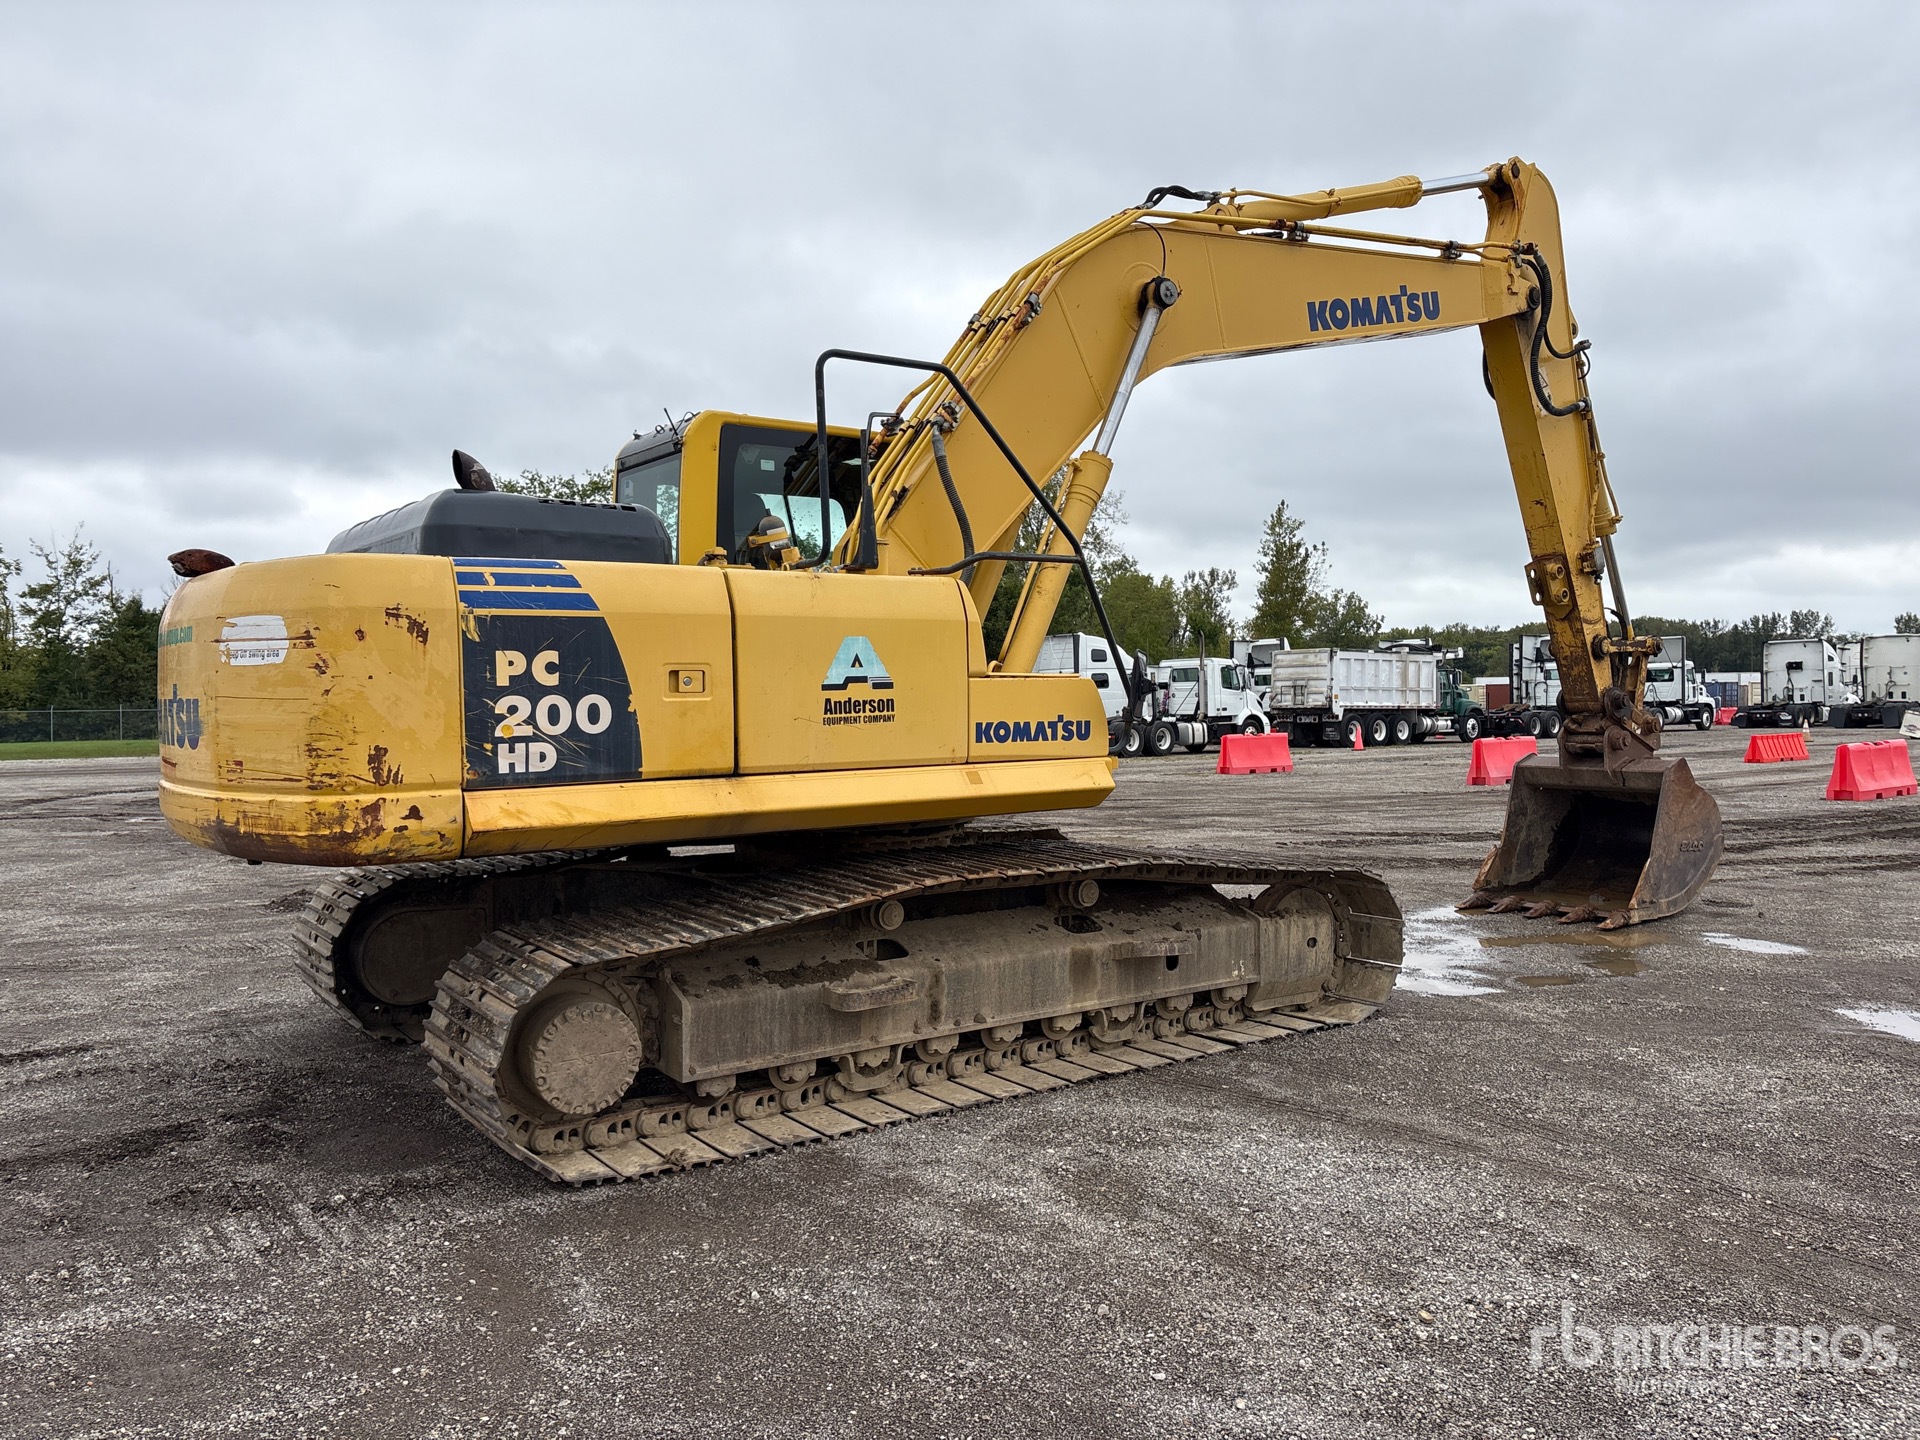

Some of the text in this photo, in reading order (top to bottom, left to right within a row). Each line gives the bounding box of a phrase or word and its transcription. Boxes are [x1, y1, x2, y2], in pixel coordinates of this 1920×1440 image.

[1307, 284, 1441, 332] KOMATSU
[495, 649, 560, 687] PC
[158, 683, 201, 751] ATSU
[494, 693, 613, 738] 200
[822, 713, 896, 727] EQUIPMENT COMPANY
[823, 696, 896, 716] Anderson
[975, 714, 1092, 744] KOMATSU
[497, 741, 557, 774] HD
